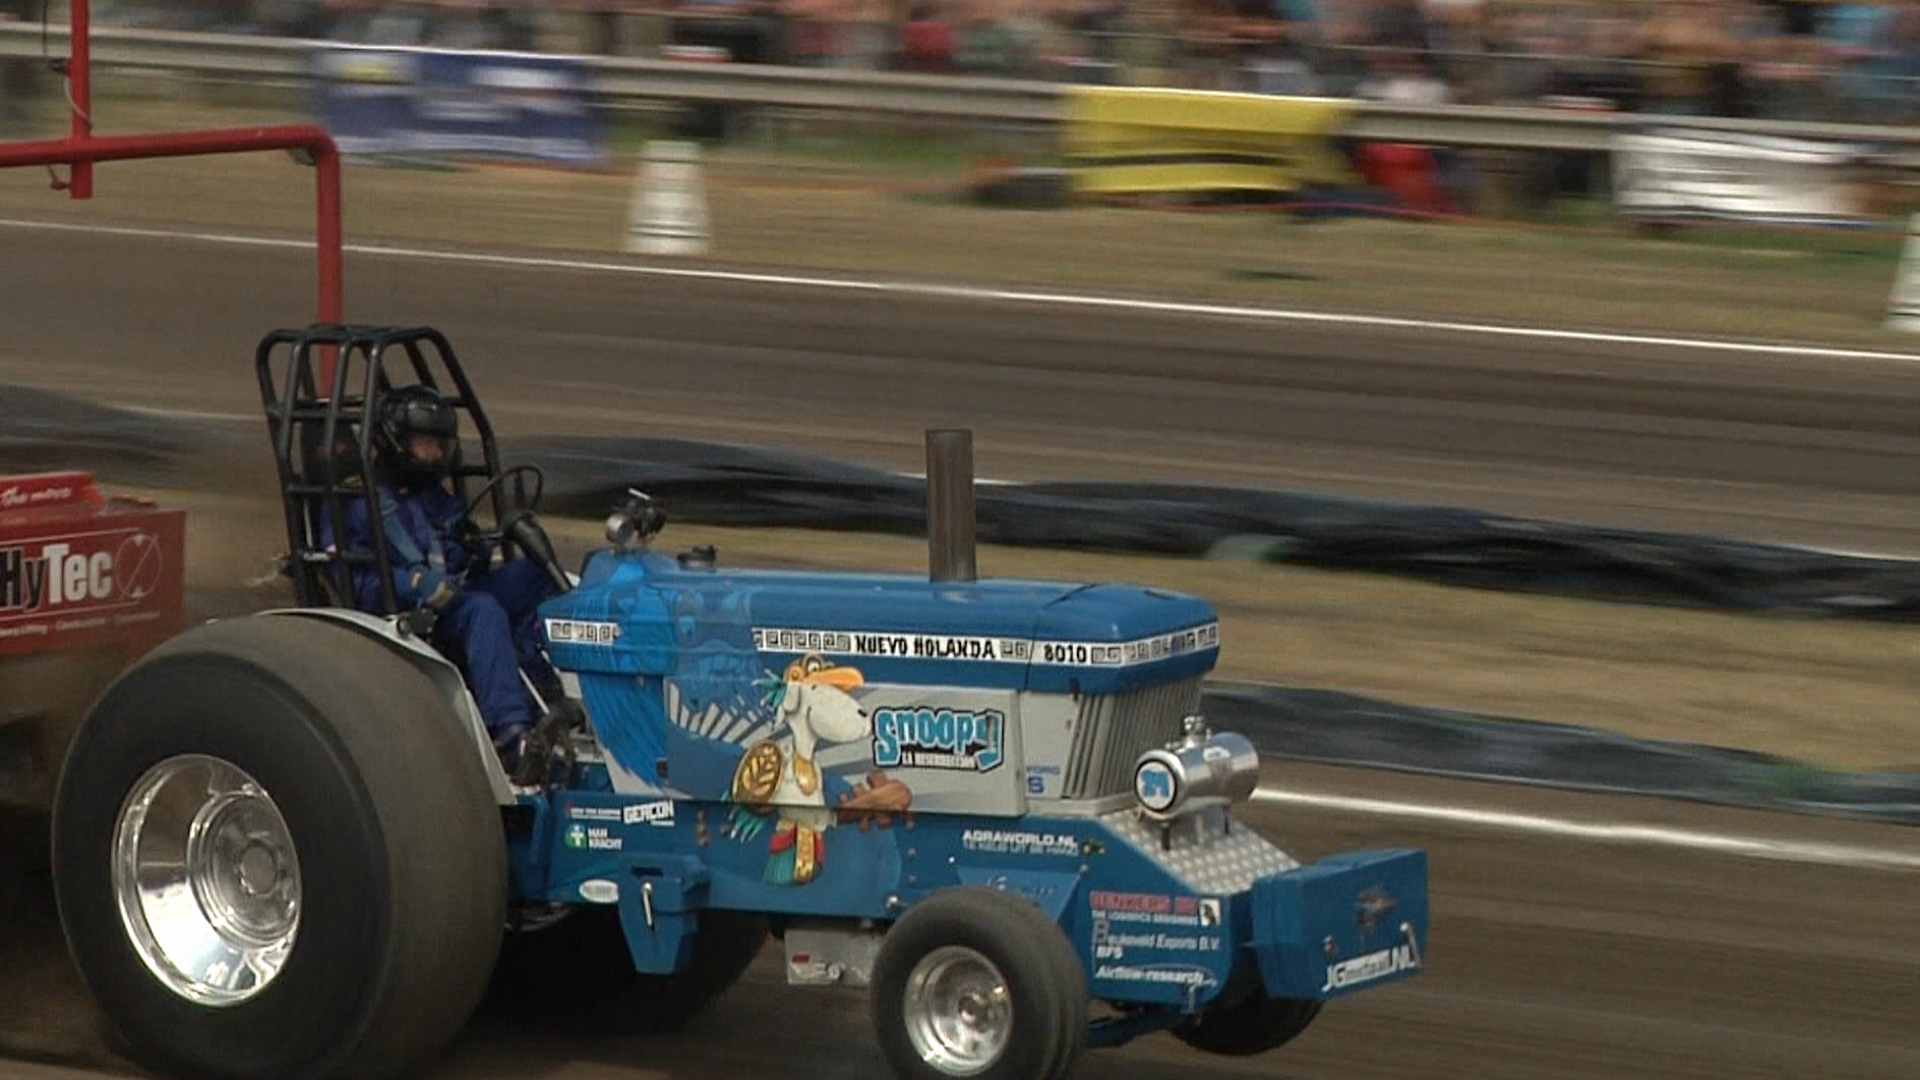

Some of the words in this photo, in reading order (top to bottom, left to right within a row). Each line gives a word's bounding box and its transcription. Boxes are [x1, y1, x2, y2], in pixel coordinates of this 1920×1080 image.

[0, 543, 113, 612] HyTec
[856, 635, 908, 656] NUEVO
[913, 637, 996, 659] HOLANDA
[1045, 644, 1087, 663] 8010
[962, 829, 1077, 847] AGRAWORLD.NL
